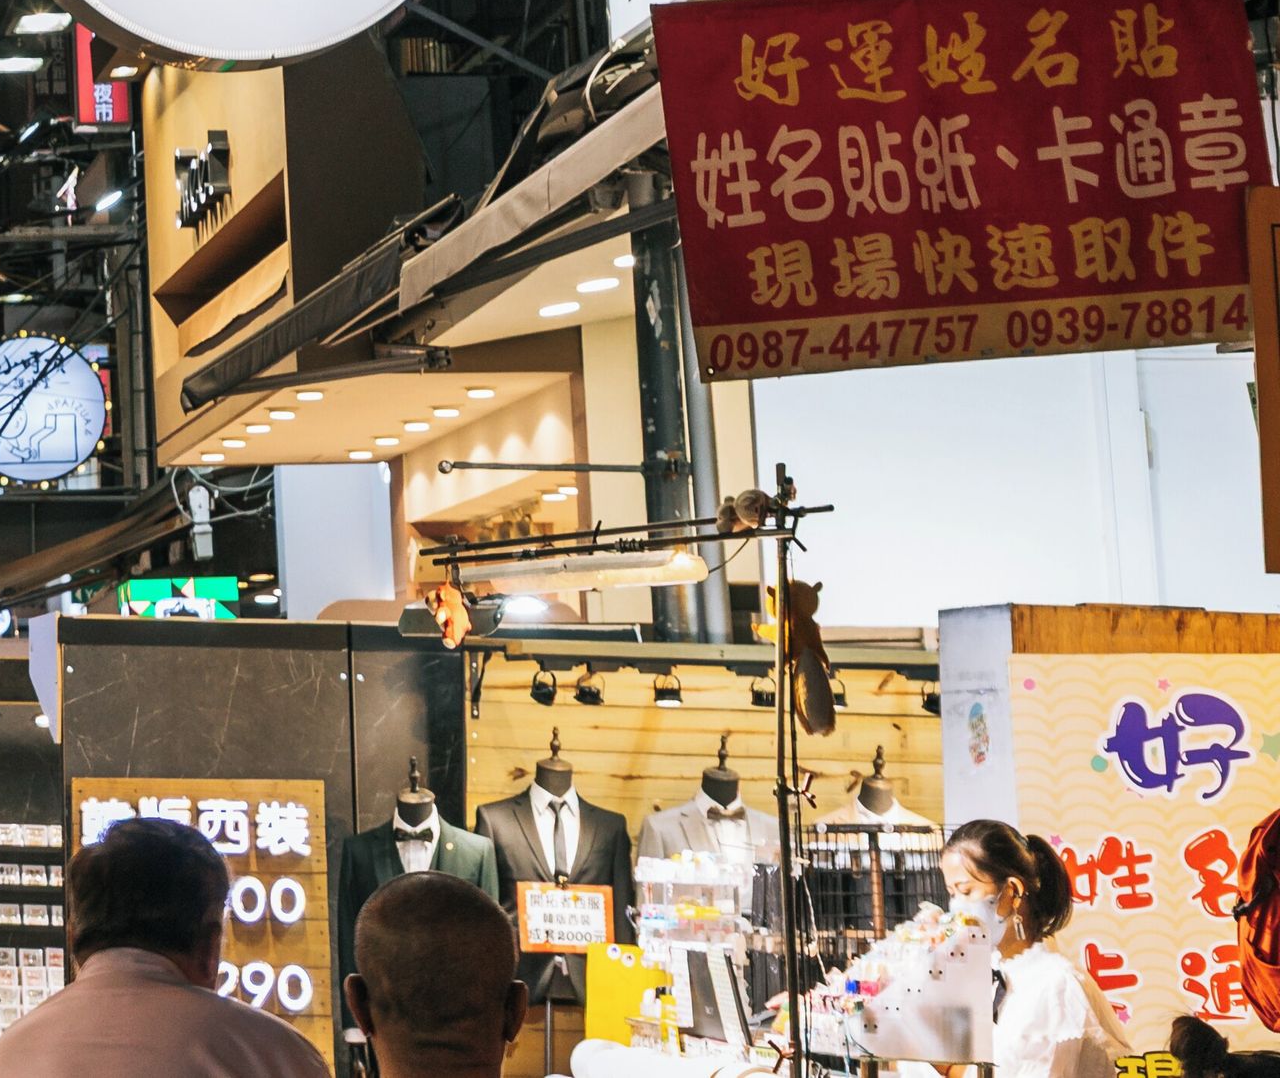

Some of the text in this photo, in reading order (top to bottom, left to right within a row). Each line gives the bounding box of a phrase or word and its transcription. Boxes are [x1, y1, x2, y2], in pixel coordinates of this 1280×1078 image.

[733, 2, 1181, 107] 好運姓名貼
[690, 93, 1251, 231] 姓名貼紙、卡通章
[746, 210, 1216, 309] 現場快速取件
[708, 313, 980, 374] 0987-447757
[1102, 692, 1251, 800] 好
